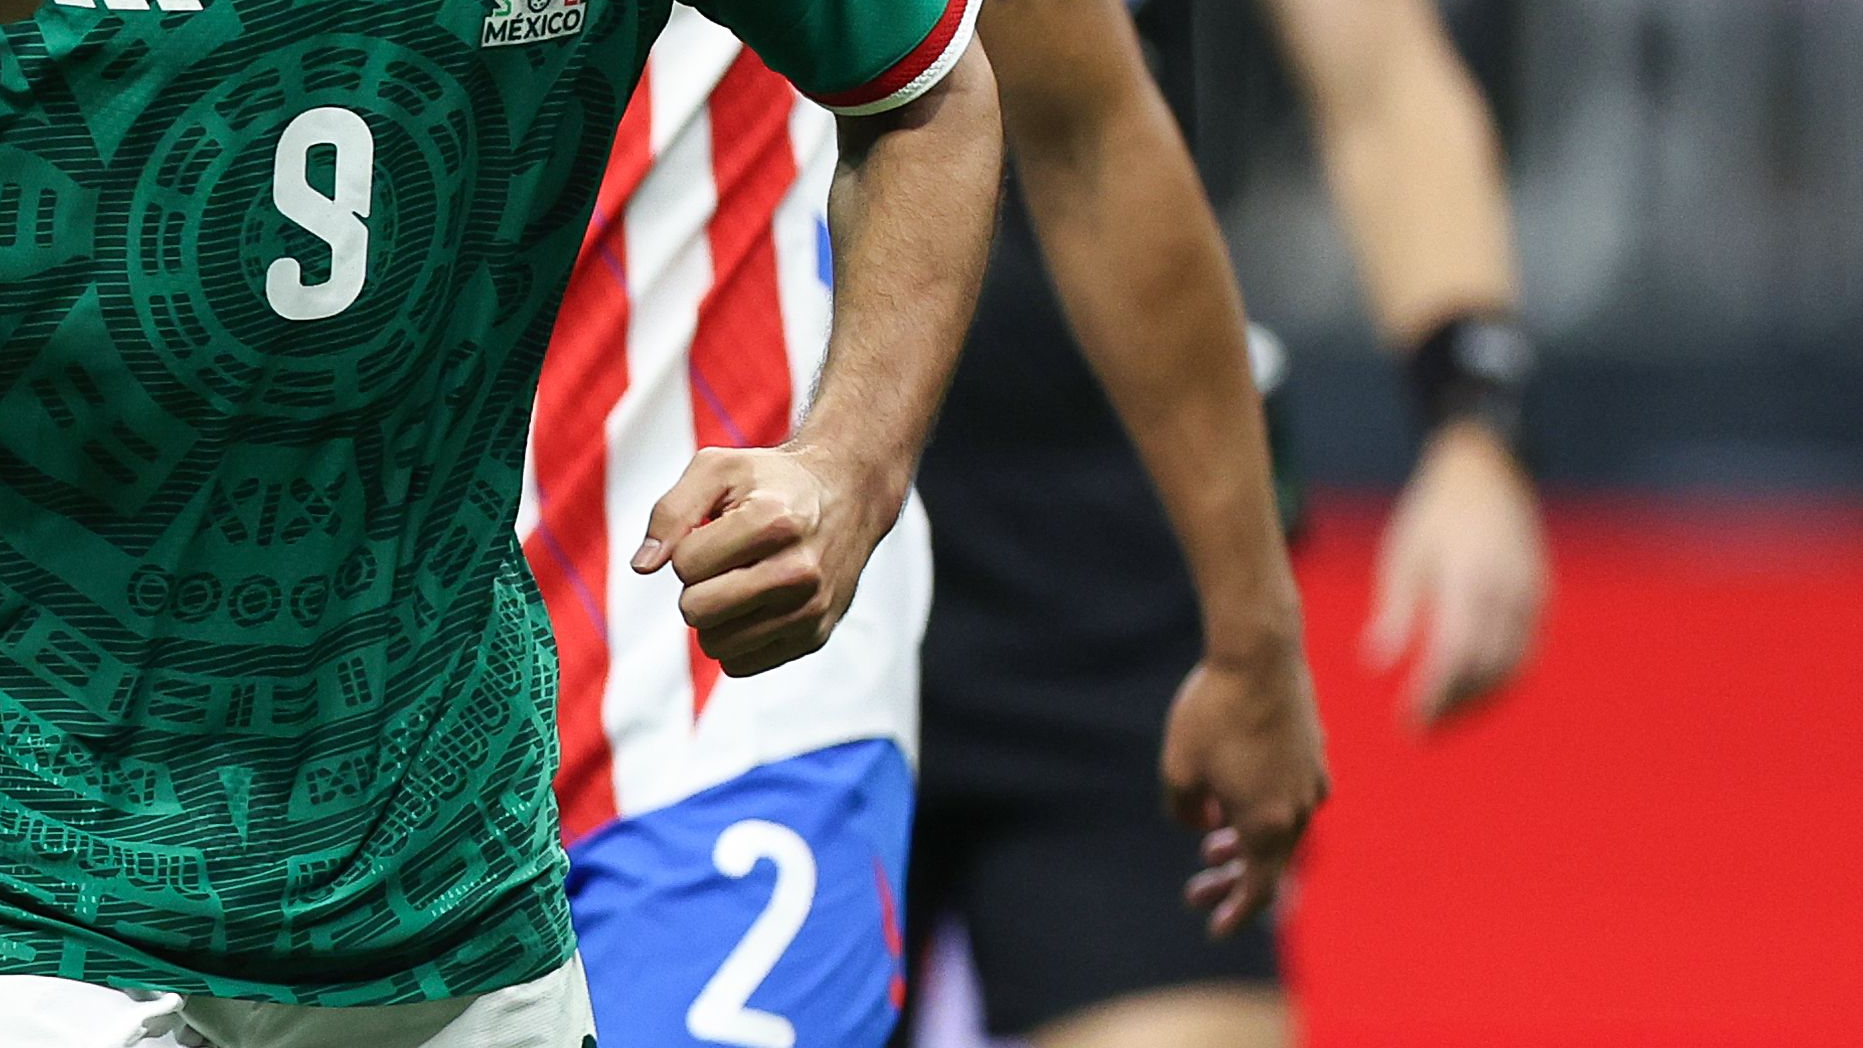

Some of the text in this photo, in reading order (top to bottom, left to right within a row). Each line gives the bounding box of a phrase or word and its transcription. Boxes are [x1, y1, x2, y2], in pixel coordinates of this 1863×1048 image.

[485, 10, 581, 43] MÉXICO
[266, 107, 374, 320] 9
[687, 818, 818, 1048] 2
